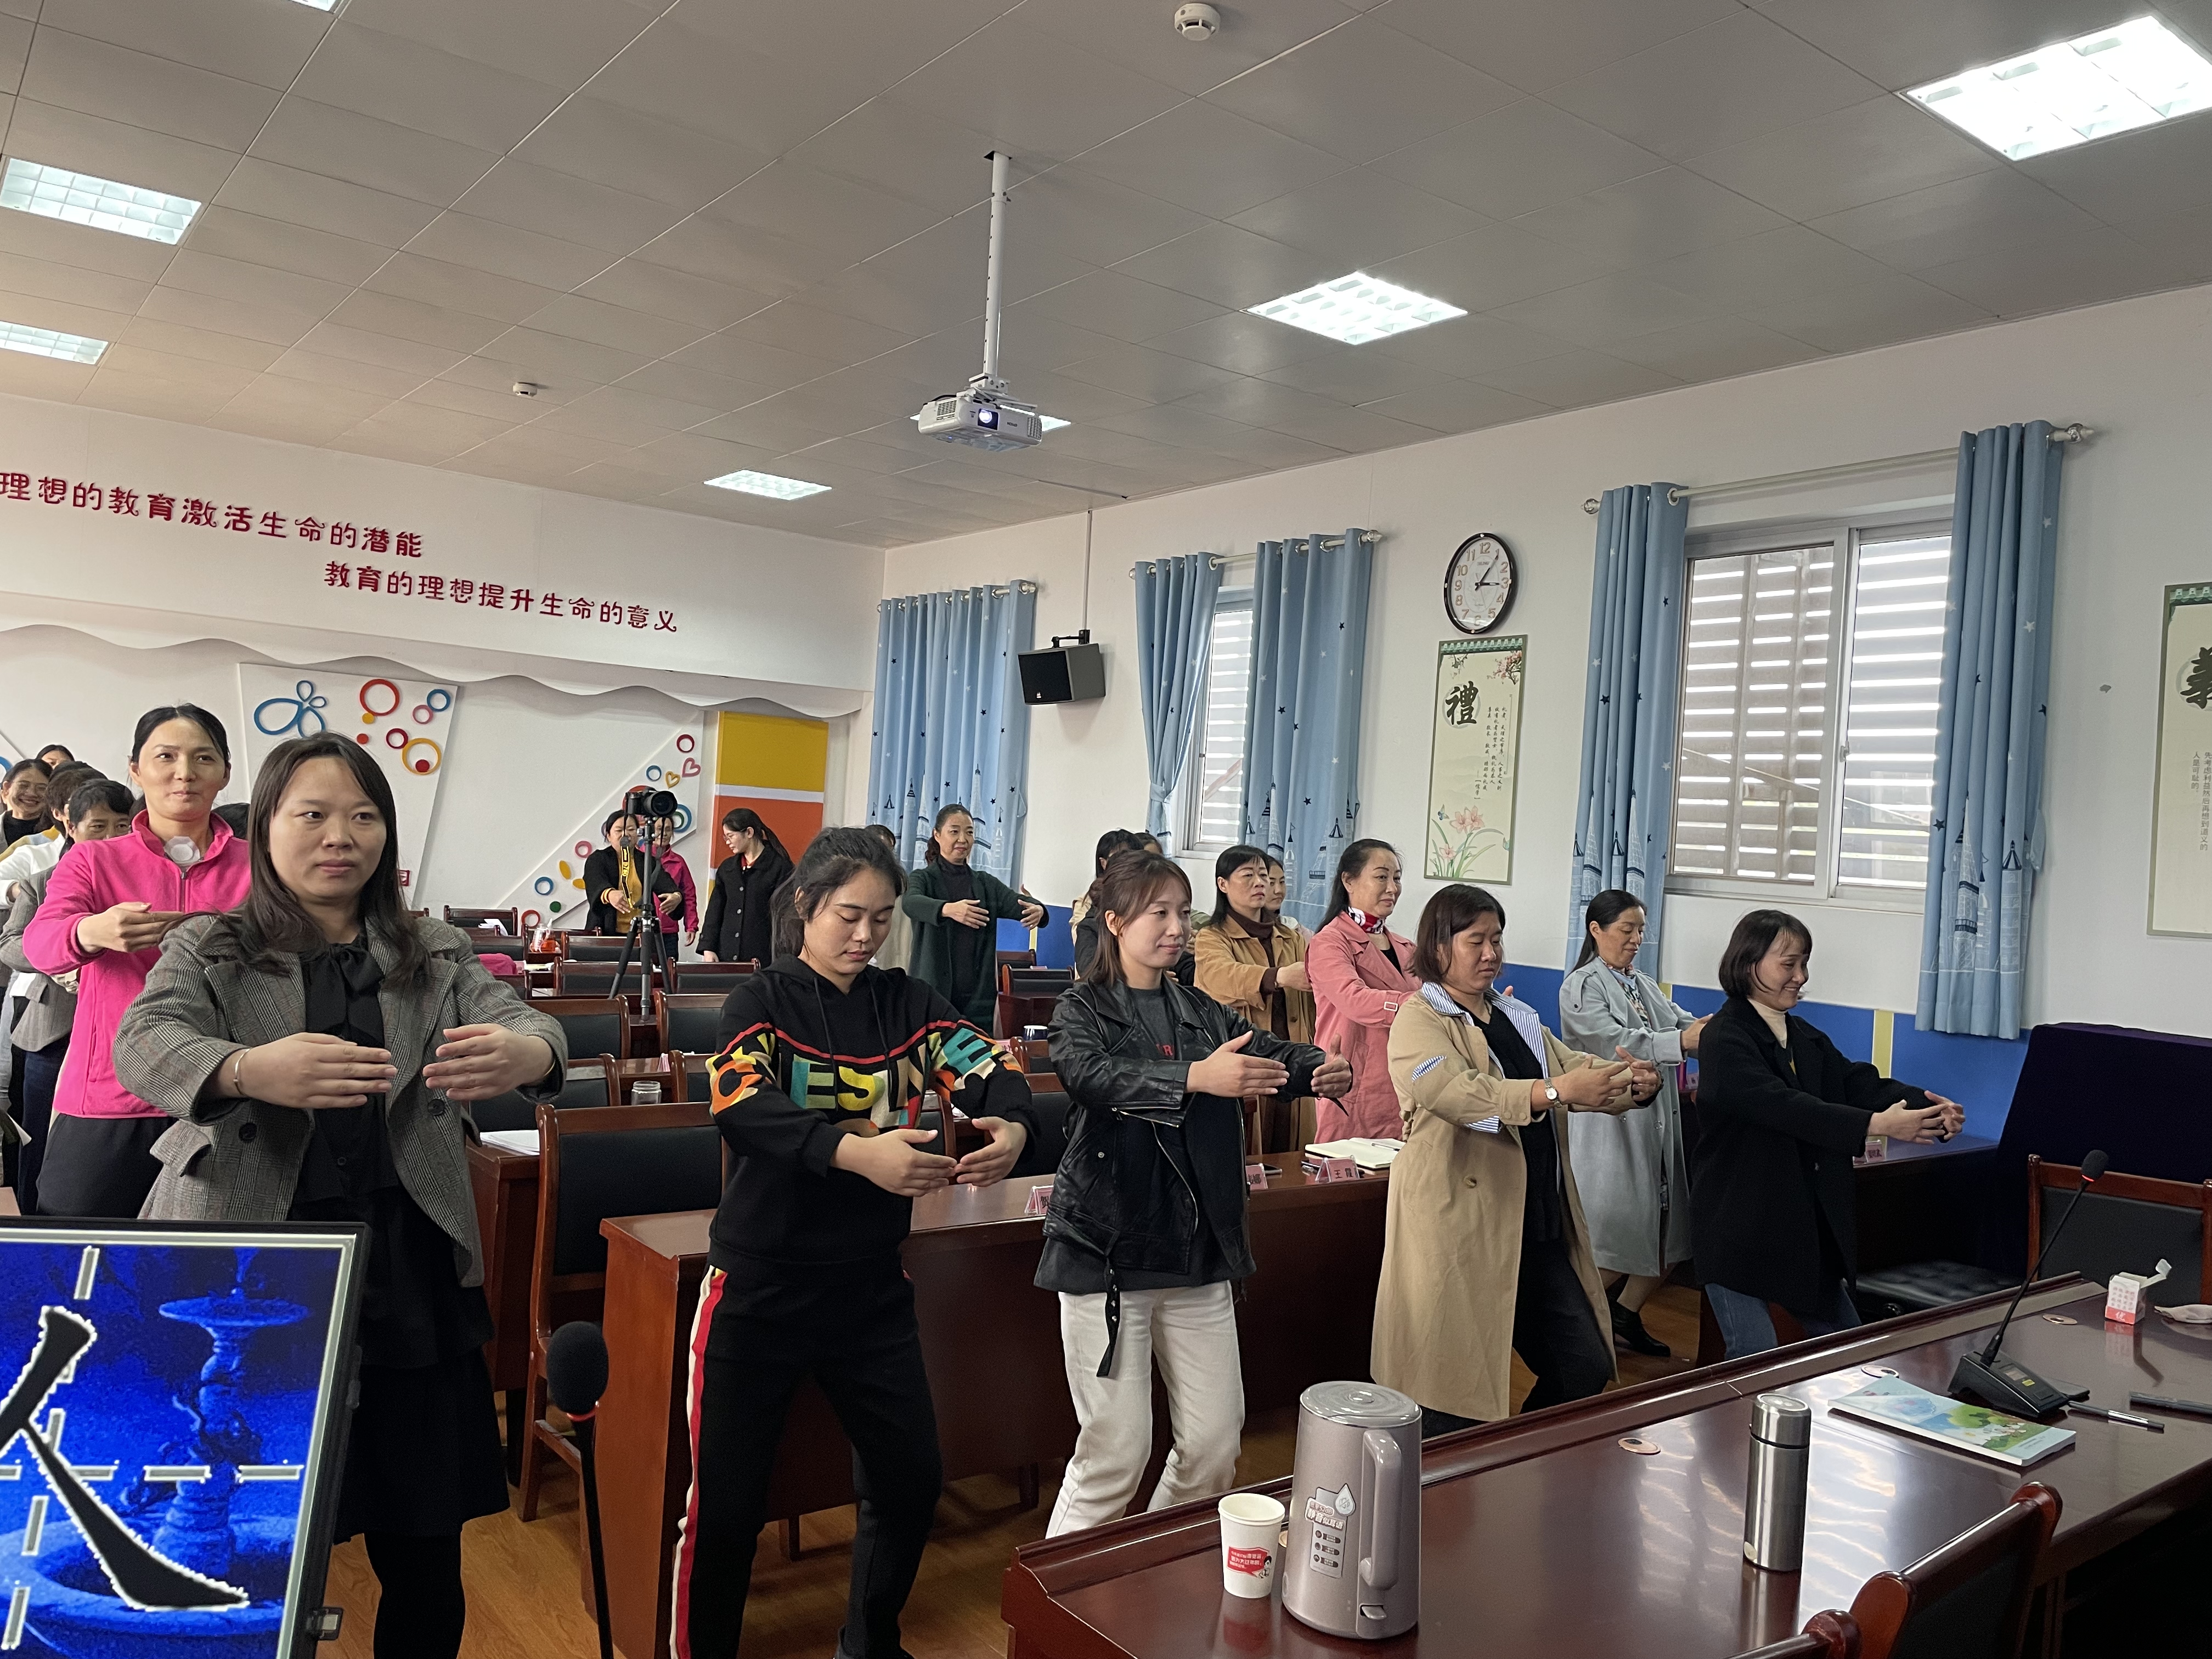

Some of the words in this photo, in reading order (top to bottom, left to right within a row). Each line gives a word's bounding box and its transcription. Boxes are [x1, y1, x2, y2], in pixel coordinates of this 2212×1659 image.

[0, 472, 421, 557] 理想的教育激活生命的潜能
[1480, 542, 1491, 554] 12
[1466, 549, 1475, 561] 11
[1457, 565, 1468, 576] 10
[1500, 562, 1508, 573] 2
[1454, 580, 1462, 591] 9
[1500, 577, 1509, 589] 3
[325, 561, 676, 632] 教育的理想提升生命的意义
[1455, 595, 1463, 606] 8
[1496, 592, 1504, 604] 4
[1462, 609, 1469, 619] 7
[1488, 608, 1496, 618] 5
